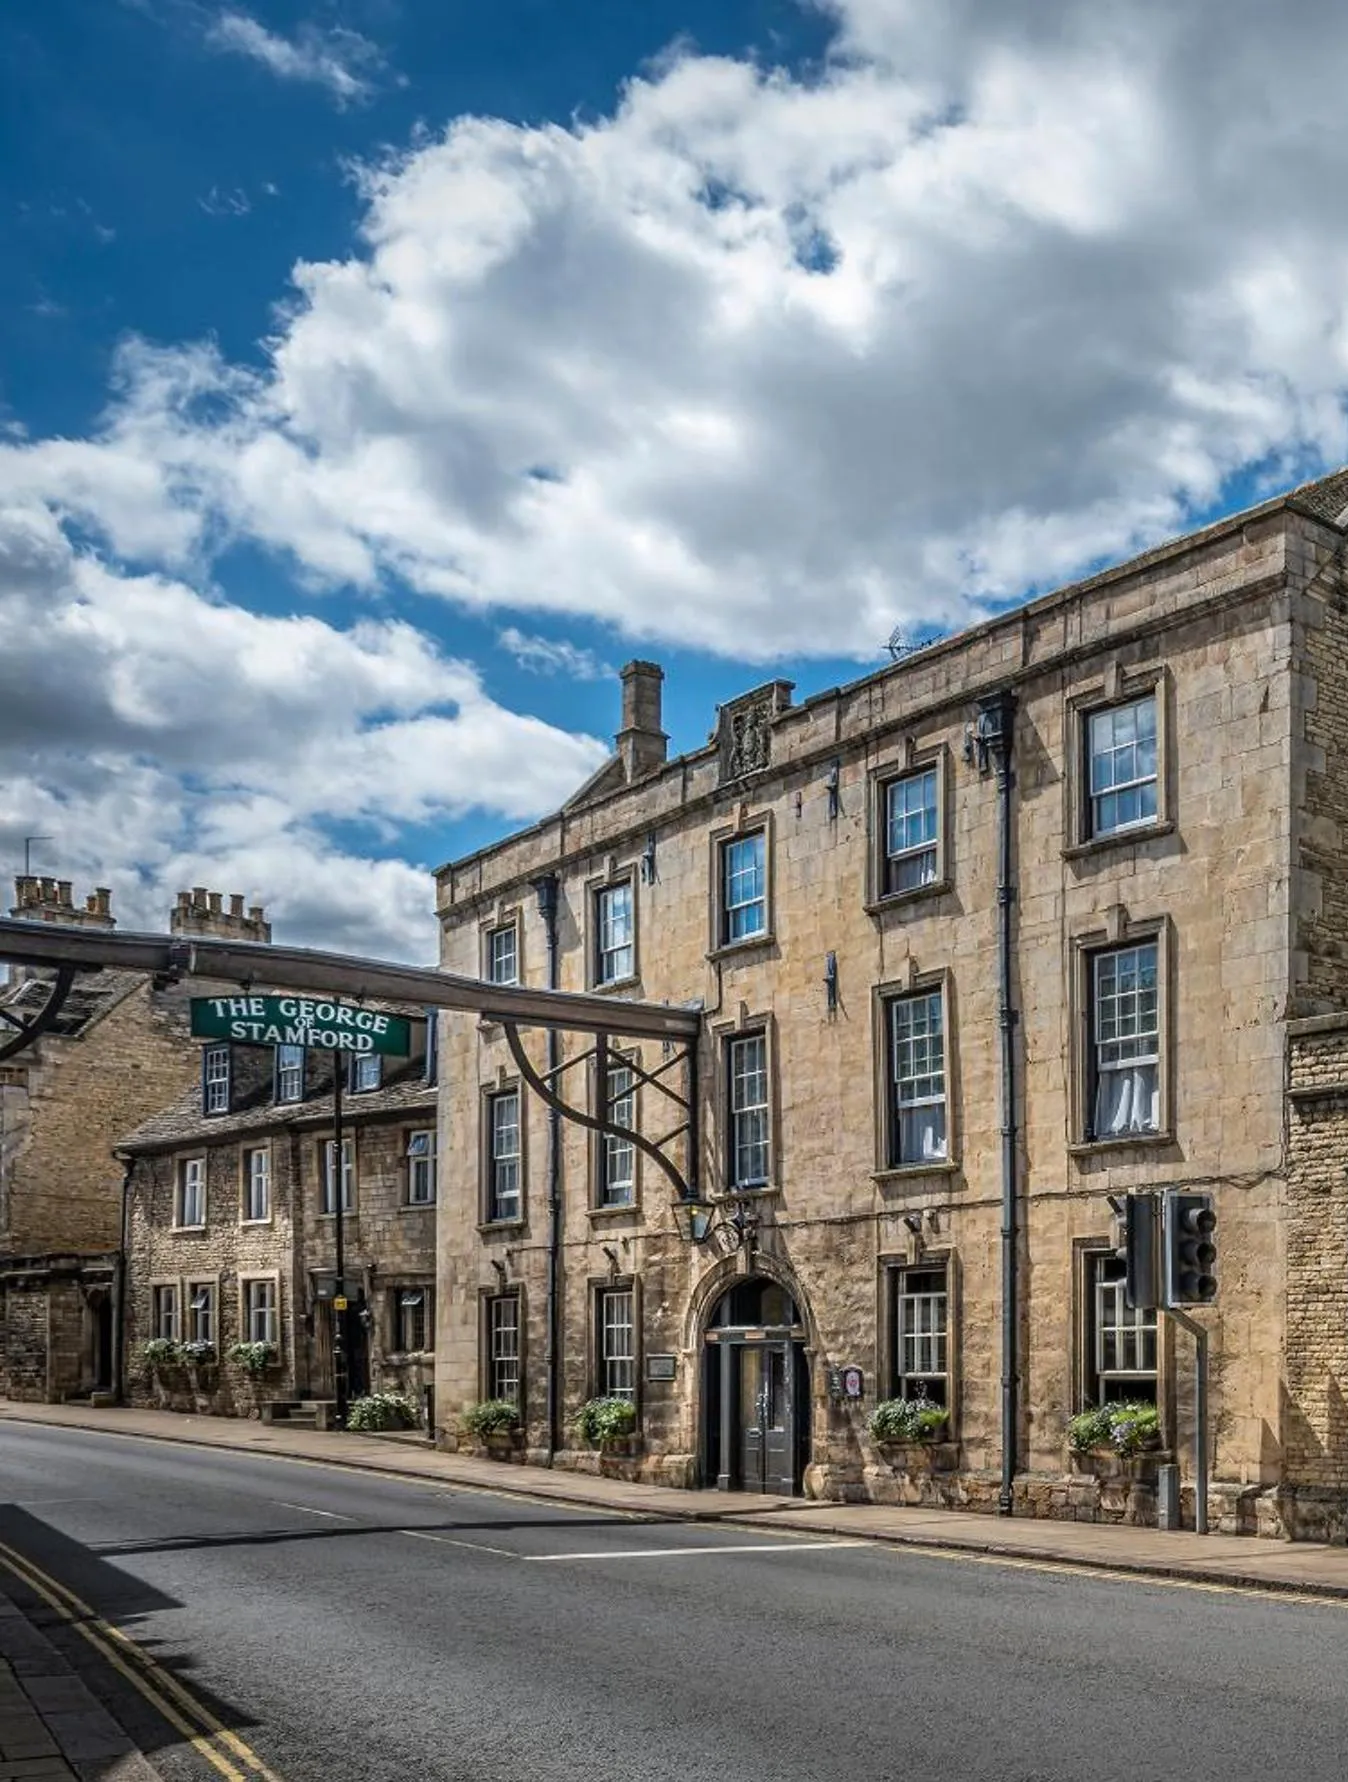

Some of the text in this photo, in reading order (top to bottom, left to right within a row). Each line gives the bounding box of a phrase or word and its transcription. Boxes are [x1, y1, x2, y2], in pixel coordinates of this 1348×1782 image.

[208, 998, 389, 1034] THE GEORGE
[294, 1016, 315, 1029] OF
[231, 1021, 374, 1051] STAMFORD
